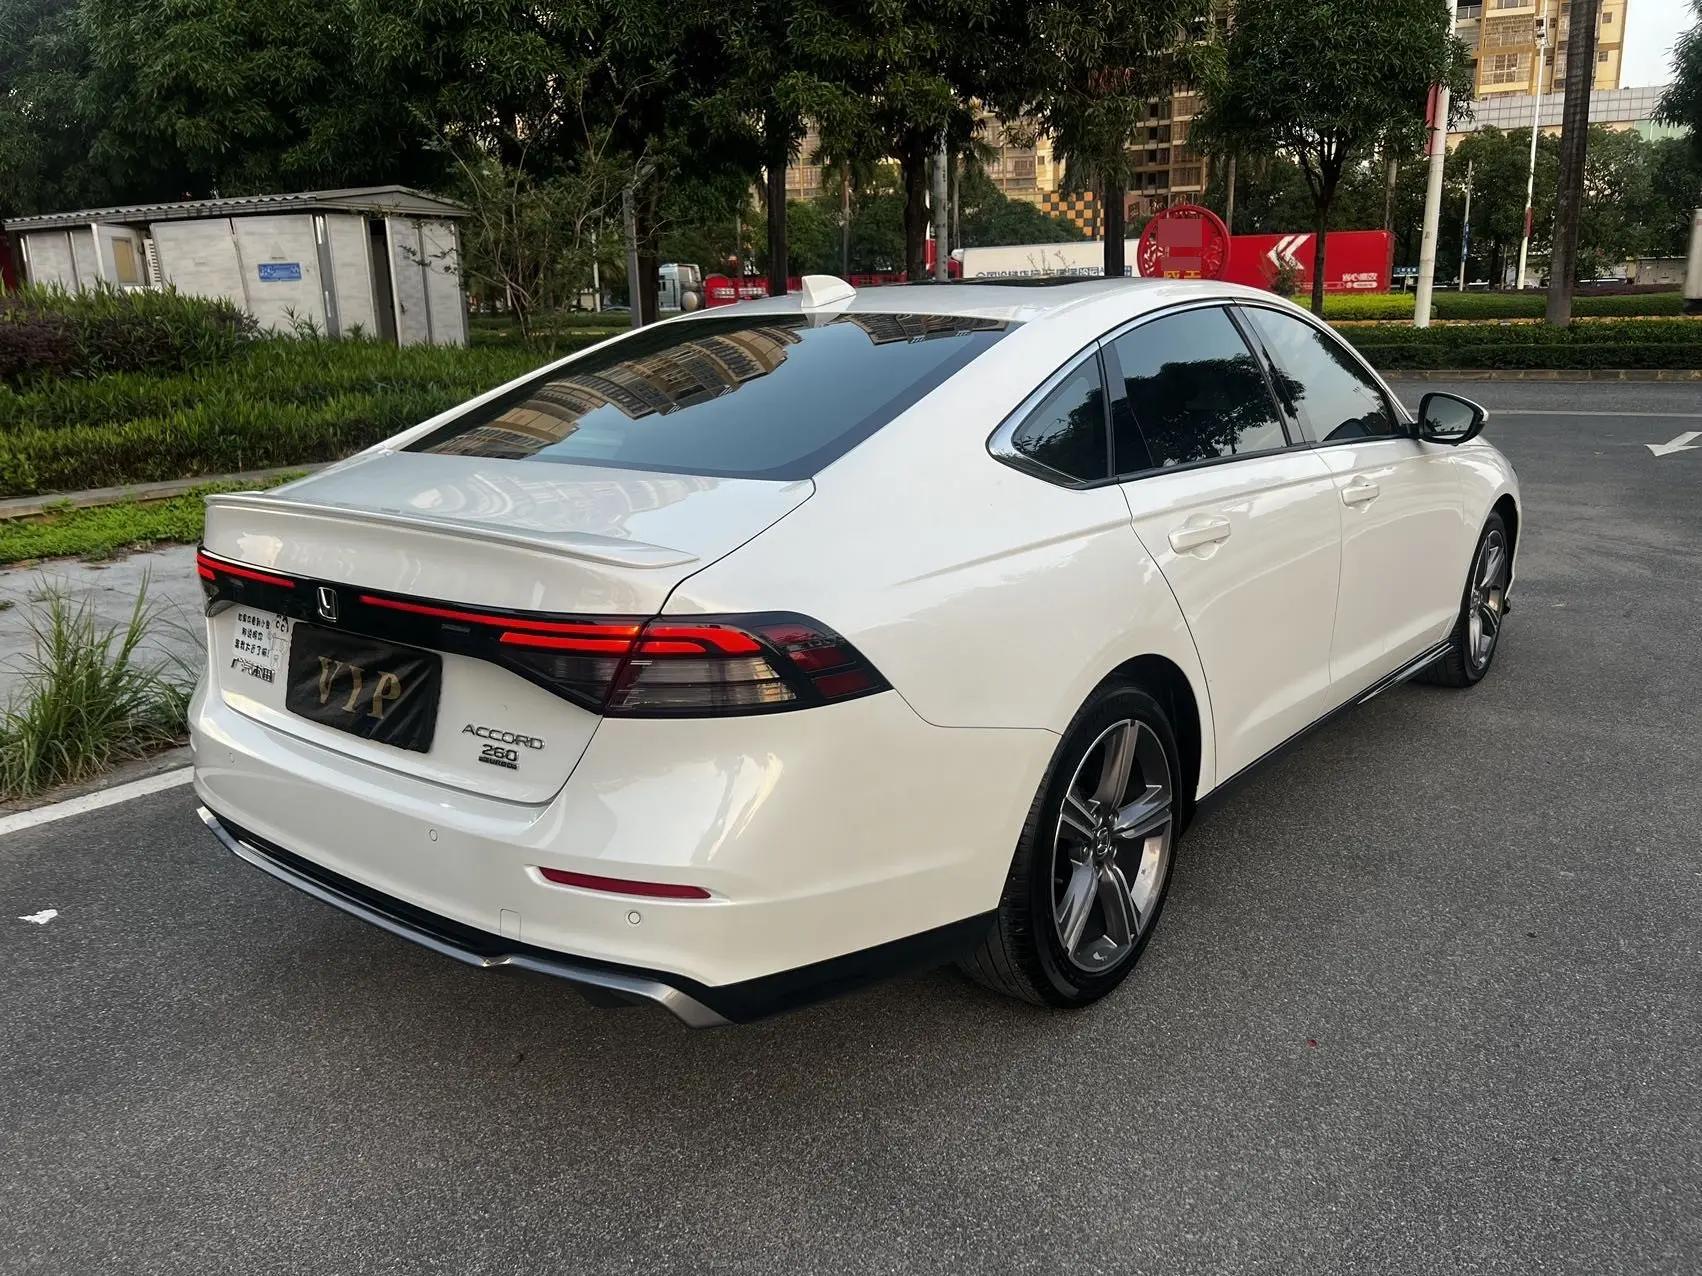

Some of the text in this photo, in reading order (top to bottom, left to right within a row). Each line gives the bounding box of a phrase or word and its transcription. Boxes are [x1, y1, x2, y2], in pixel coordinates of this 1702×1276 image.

[231, 658, 274, 684] 广汽本田
[318, 656, 401, 720] VIP
[461, 724, 544, 750] ACCORD
[482, 743, 518, 762] 260
